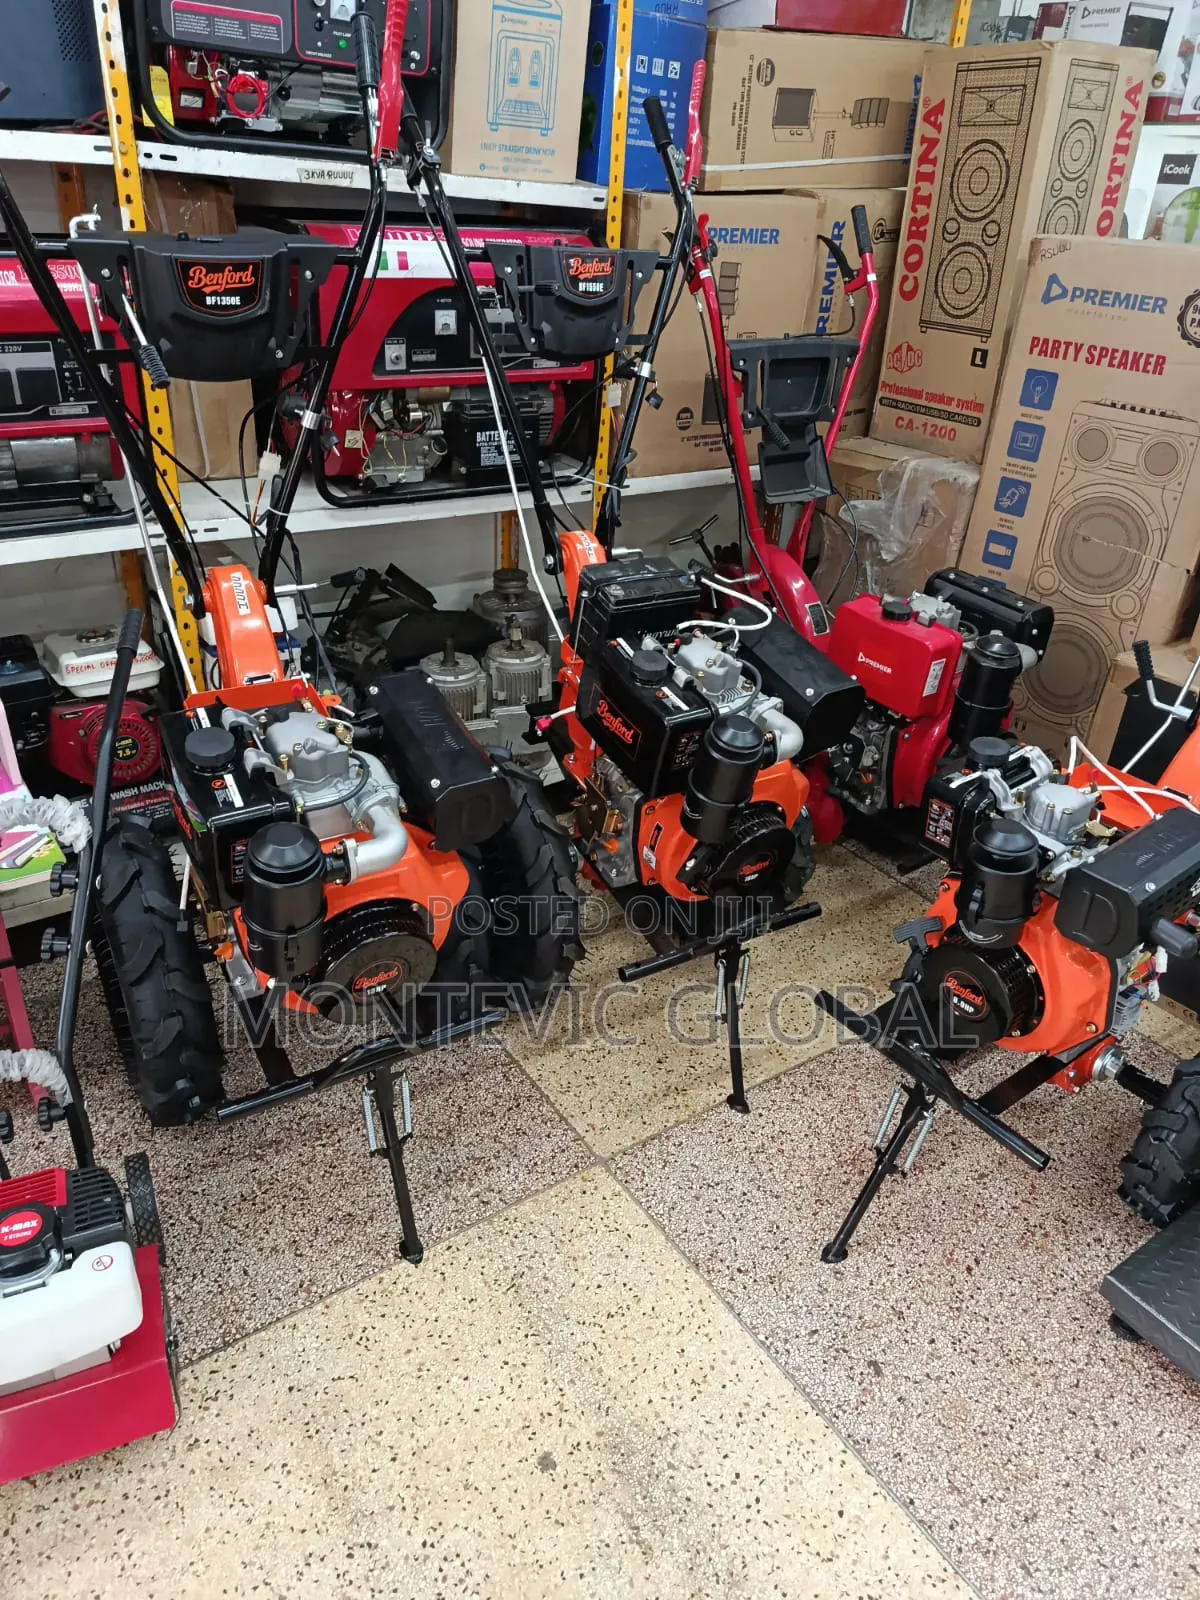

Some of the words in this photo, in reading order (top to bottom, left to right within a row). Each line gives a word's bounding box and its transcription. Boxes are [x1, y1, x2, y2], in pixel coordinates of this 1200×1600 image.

[1091, 6, 1121, 15] PREMIER
[1096, 79, 1144, 238] ORTINA
[1163, 164, 1191, 175] iCook
[899, 97, 946, 302] CORTINA
[708, 227, 780, 244] PREMIER
[188, 264, 255, 294] Benford
[569, 257, 613, 280] Benford
[205, 295, 241, 305] BF1350E
[1070, 287, 1168, 314] PREMIER
[1029, 336, 1085, 362] PARTY
[1085, 344, 1167, 376] SPEAKER
[880, 380, 924, 402] Professional
[925, 391, 955, 407] speaker
[956, 398, 985, 414] system
[477, 430, 508, 442] BATTEY
[895, 416, 957, 442] CA-1200
[65, 663, 97, 675] SPECIAL
[865, 658, 892, 674] PREMIER
[597, 699, 634, 744] Benford
[110, 787, 138, 801] WASH
[140, 780, 167, 794] MACH
[355, 966, 399, 990] Benford
[946, 977, 984, 1006] Benford
